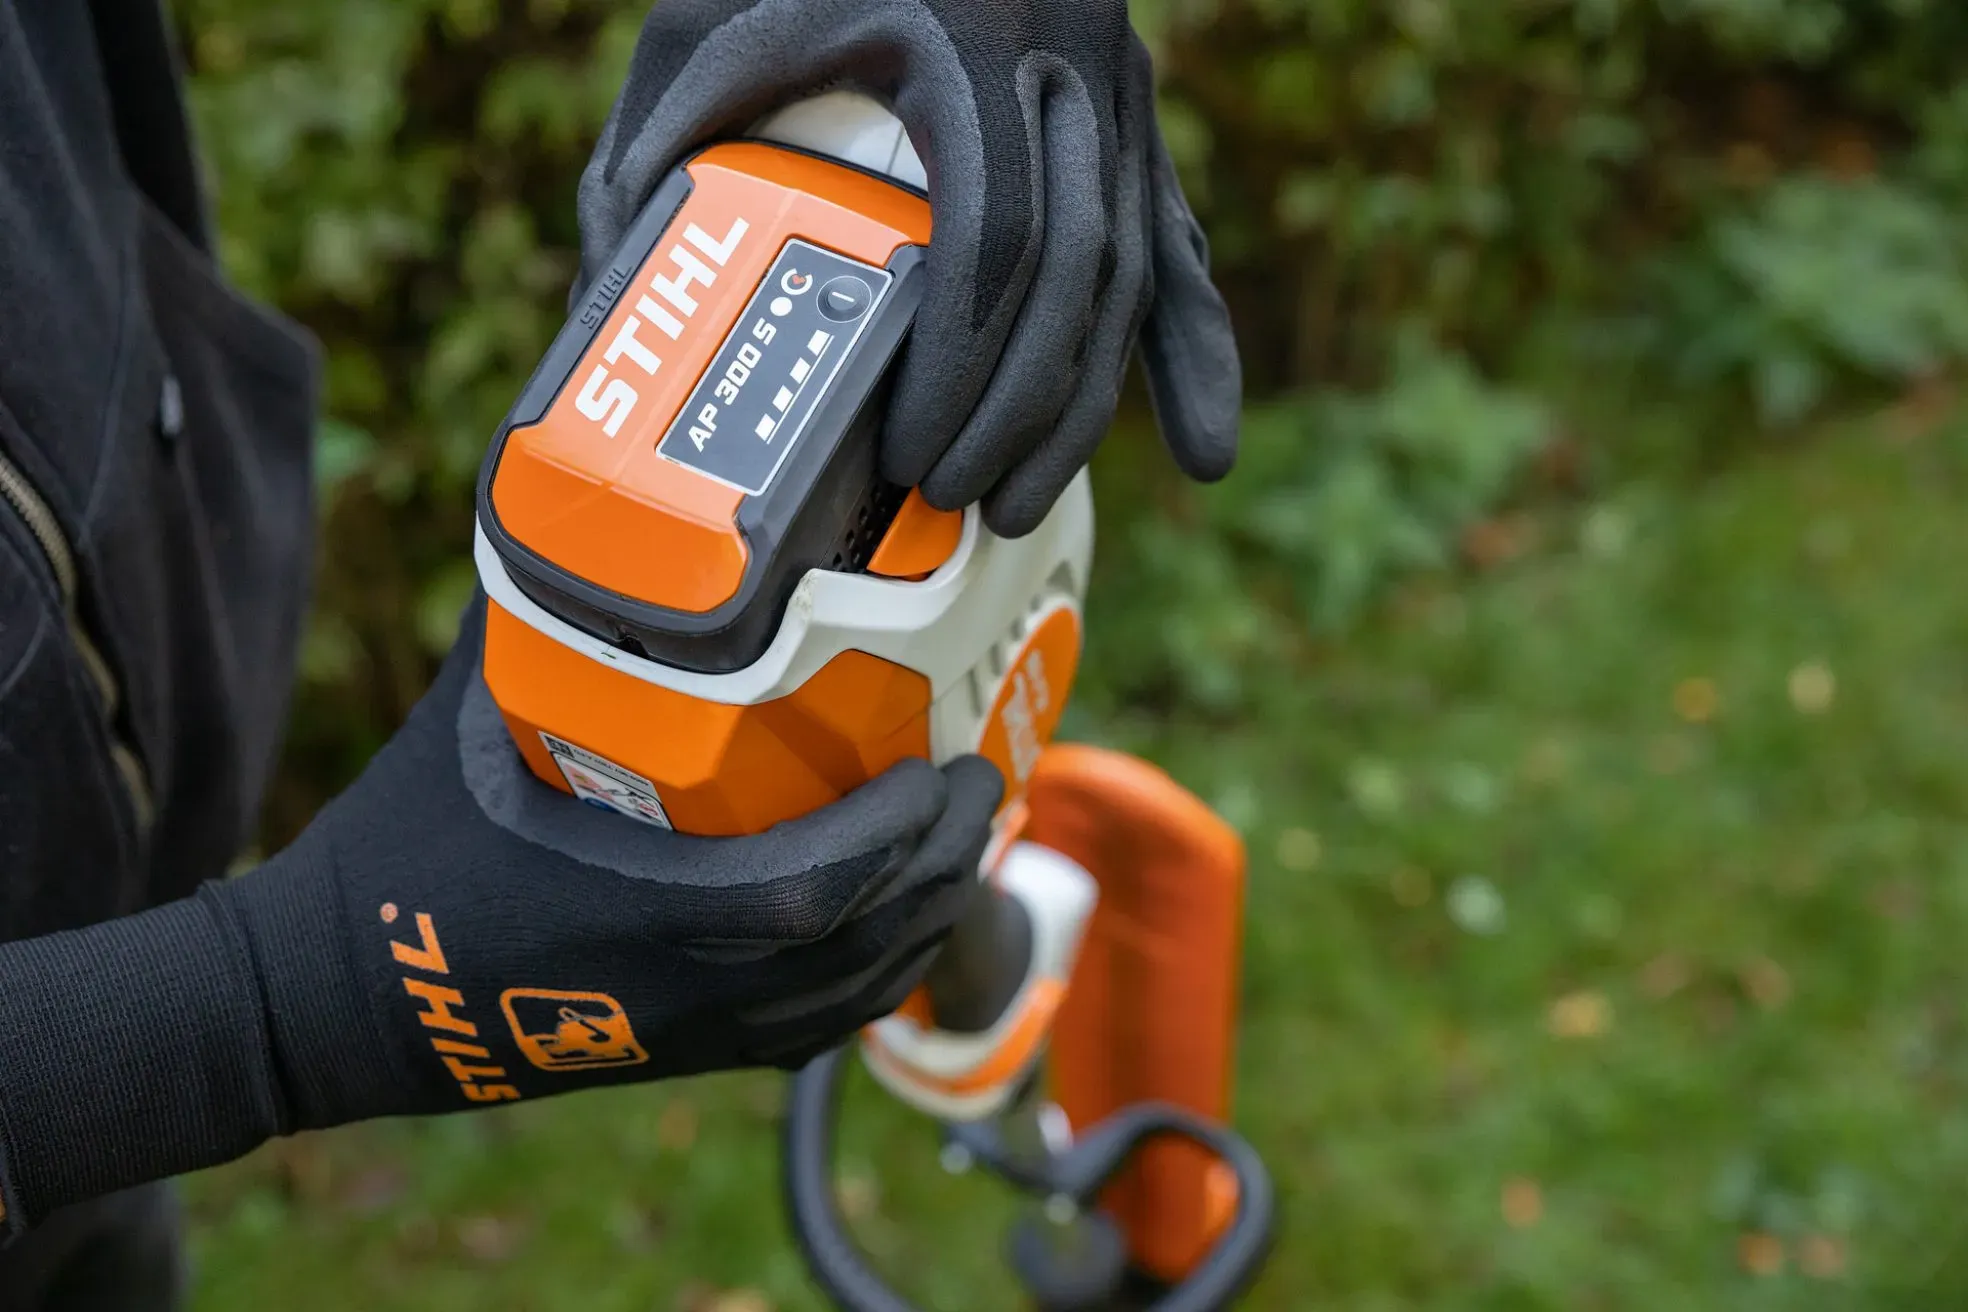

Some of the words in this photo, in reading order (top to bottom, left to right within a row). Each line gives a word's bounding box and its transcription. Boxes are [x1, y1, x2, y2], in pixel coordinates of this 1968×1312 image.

[574, 217, 750, 438] STIHL
[580, 266, 632, 329] STIHL
[688, 403, 718, 452] AP
[714, 342, 762, 405] 300
[752, 317, 777, 345] S
